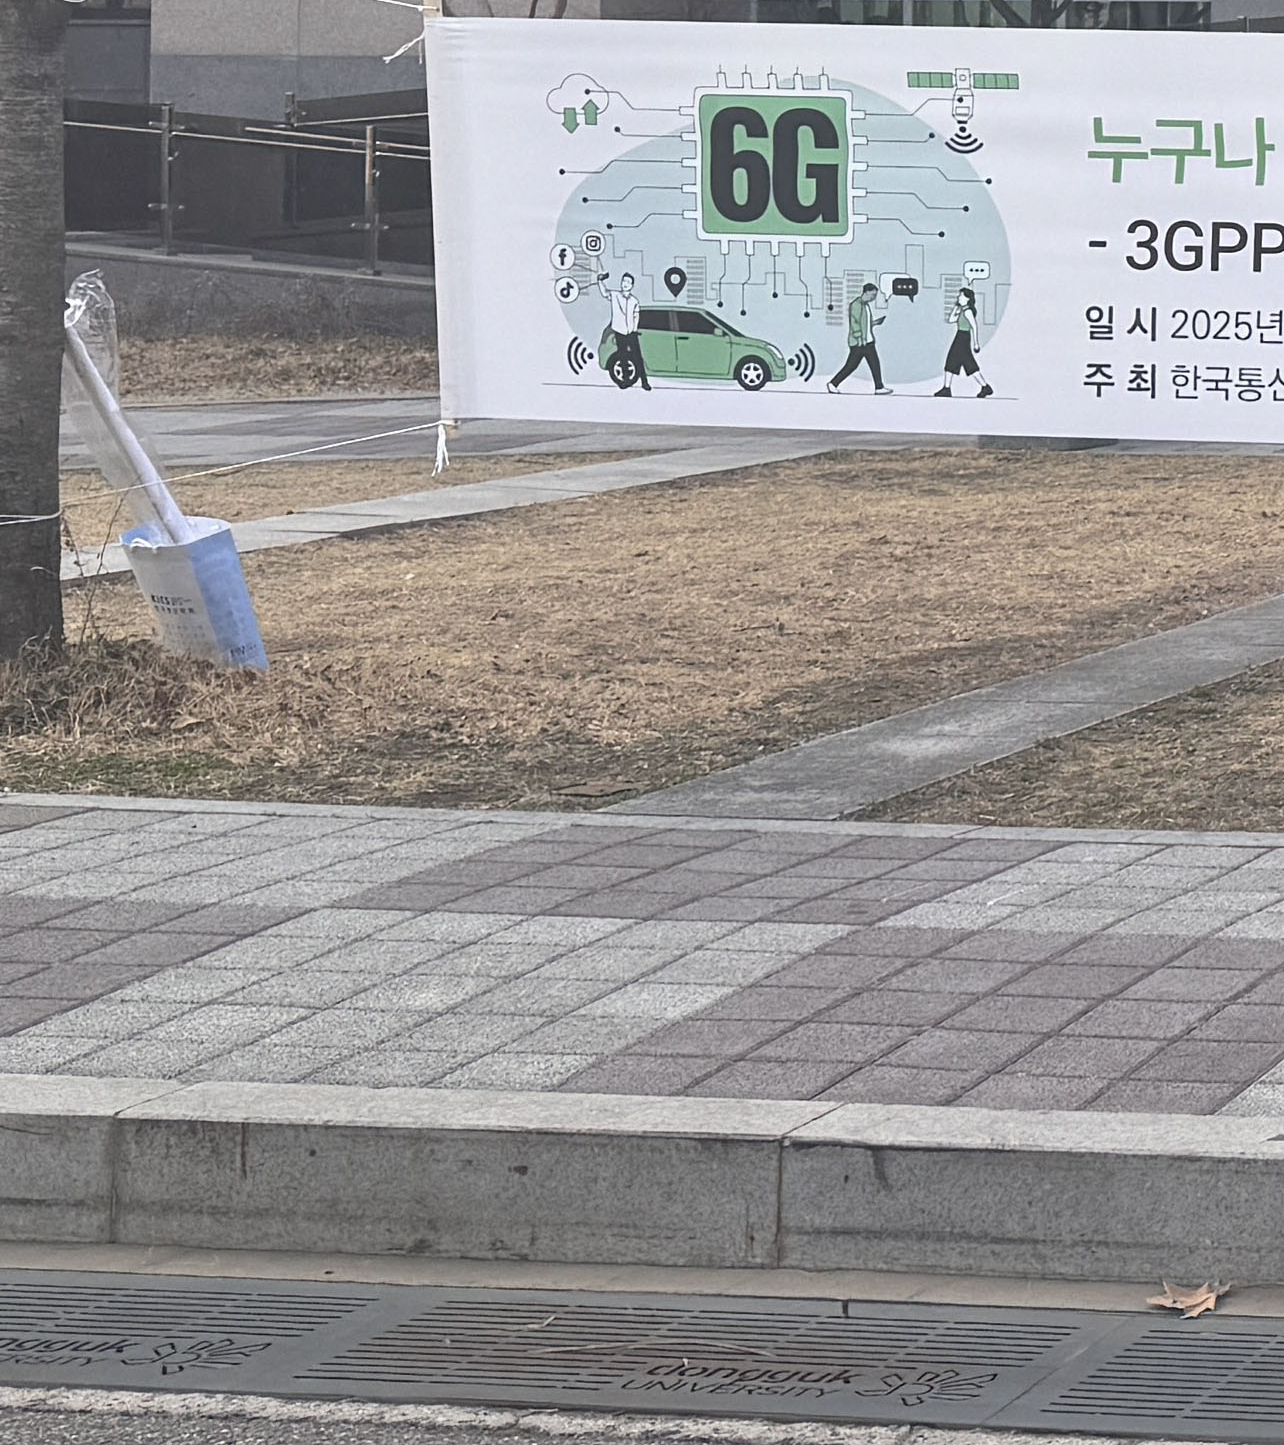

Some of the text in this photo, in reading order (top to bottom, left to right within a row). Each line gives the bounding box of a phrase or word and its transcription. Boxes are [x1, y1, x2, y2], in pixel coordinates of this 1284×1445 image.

[709, 106, 841, 225] 6G
[1087, 116, 1275, 186] 누구나
[1170, 309, 1284, 345] 2025년
[646, 1363, 860, 1385] dongguk
